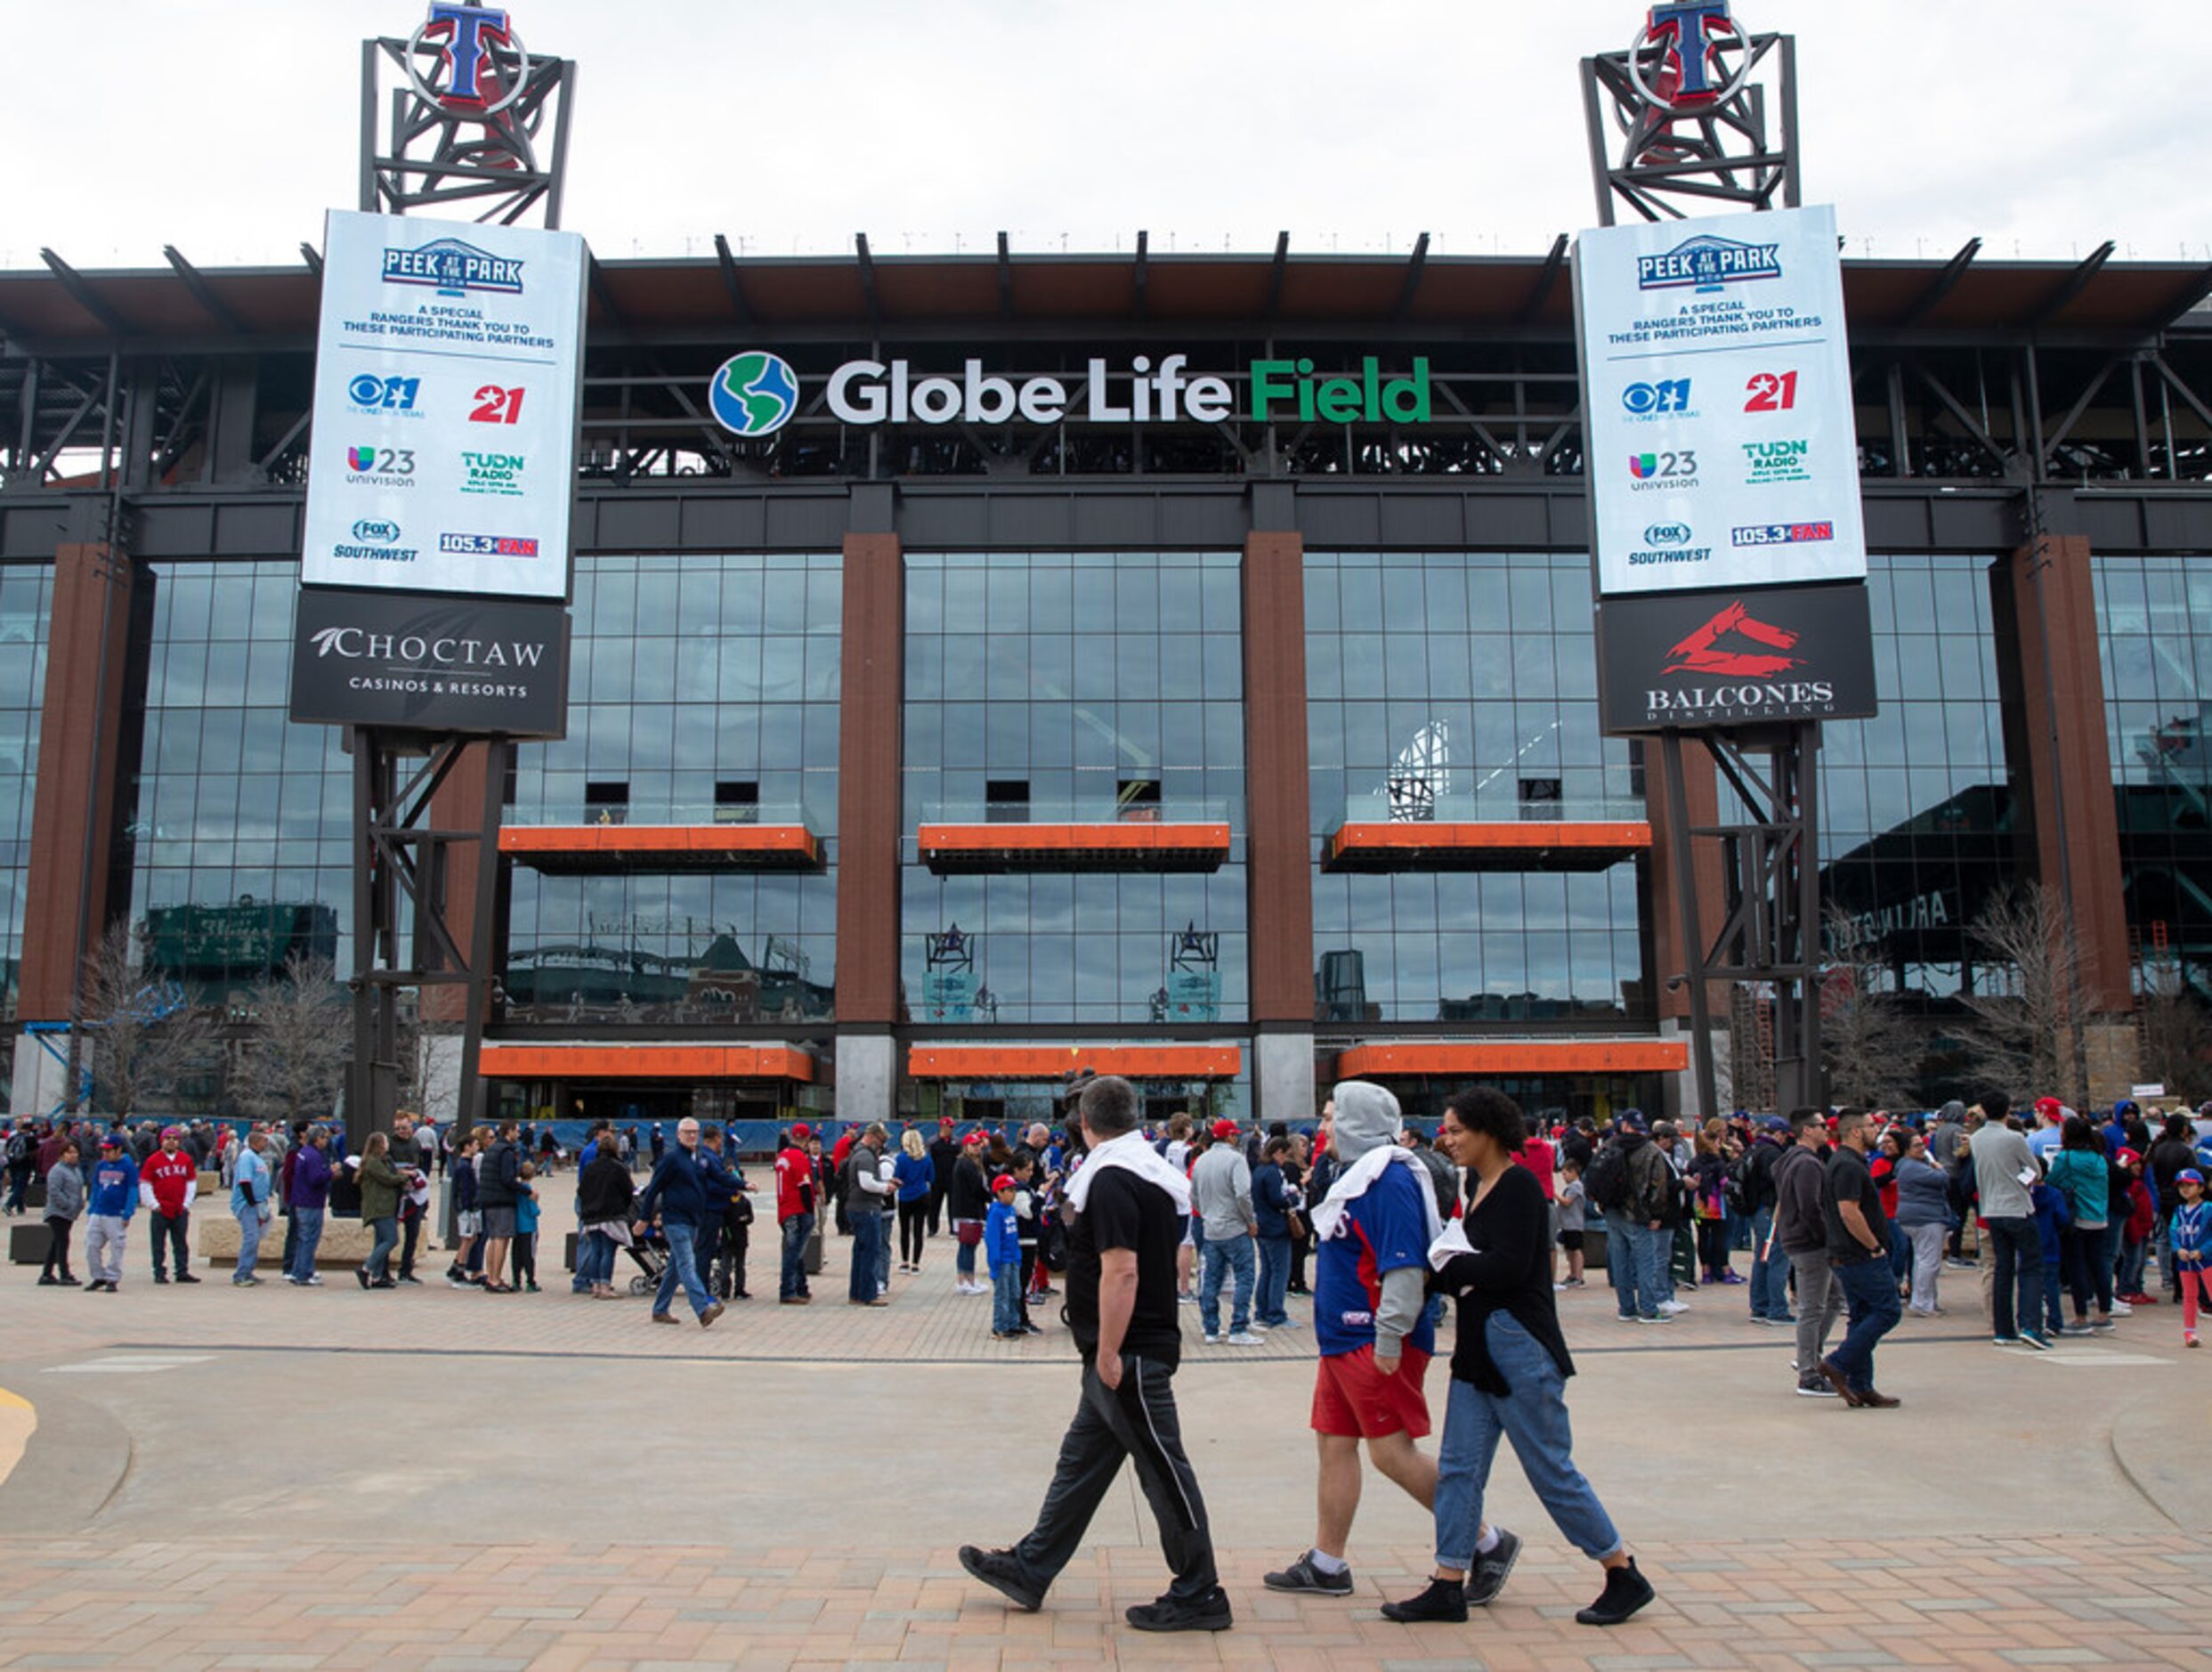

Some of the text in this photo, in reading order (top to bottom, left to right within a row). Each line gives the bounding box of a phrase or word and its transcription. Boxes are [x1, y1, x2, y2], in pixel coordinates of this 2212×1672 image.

[386, 251, 439, 275] PEEK
[447, 256, 460, 267] AT
[1641, 254, 1694, 279] PEEK
[1697, 263, 1716, 272] THE
[1699, 252, 1713, 263] AT
[1720, 247, 1776, 271] PARK
[442, 266, 461, 277] THE
[466, 258, 520, 282] PARK
[418, 304, 484, 320] A SPECIAL
[1633, 307, 1794, 330] RANGERS THANK YOU TO
[1680, 301, 1746, 315] A SPECIAL
[344, 321, 555, 348] THESE PARTICIPATING PARTNERS
[370, 312, 530, 335] RANGERS THANK YOU TO
[1608, 316, 1822, 345] THESE PARTICIPATING PARTNERS
[826, 353, 1430, 425] Globe Life Field
[1656, 377, 1690, 412] 11
[1744, 370, 1798, 412] 21
[468, 384, 526, 425] 21
[1742, 440, 1806, 458] TUDN
[378, 449, 416, 474] 23
[461, 451, 524, 470] TUDN
[1660, 450, 1697, 475] 23
[1754, 456, 1798, 468] RADIO
[470, 468, 514, 480] RADIO
[362, 523, 390, 536] FOX
[1654, 526, 1681, 541] FOX
[1734, 523, 1831, 546] 105.3 FAN
[333, 544, 419, 562] SOUTHWEST
[442, 535, 538, 556] 105.3 FAN
[1628, 548, 1712, 565] SOUTHWEST
[335, 628, 545, 667] CHOCTAW
[350, 677, 527, 698] CASINOS & RESORTS
[1646, 681, 1834, 710] BALCONES
[156, 1165, 188, 1179] TEXA
